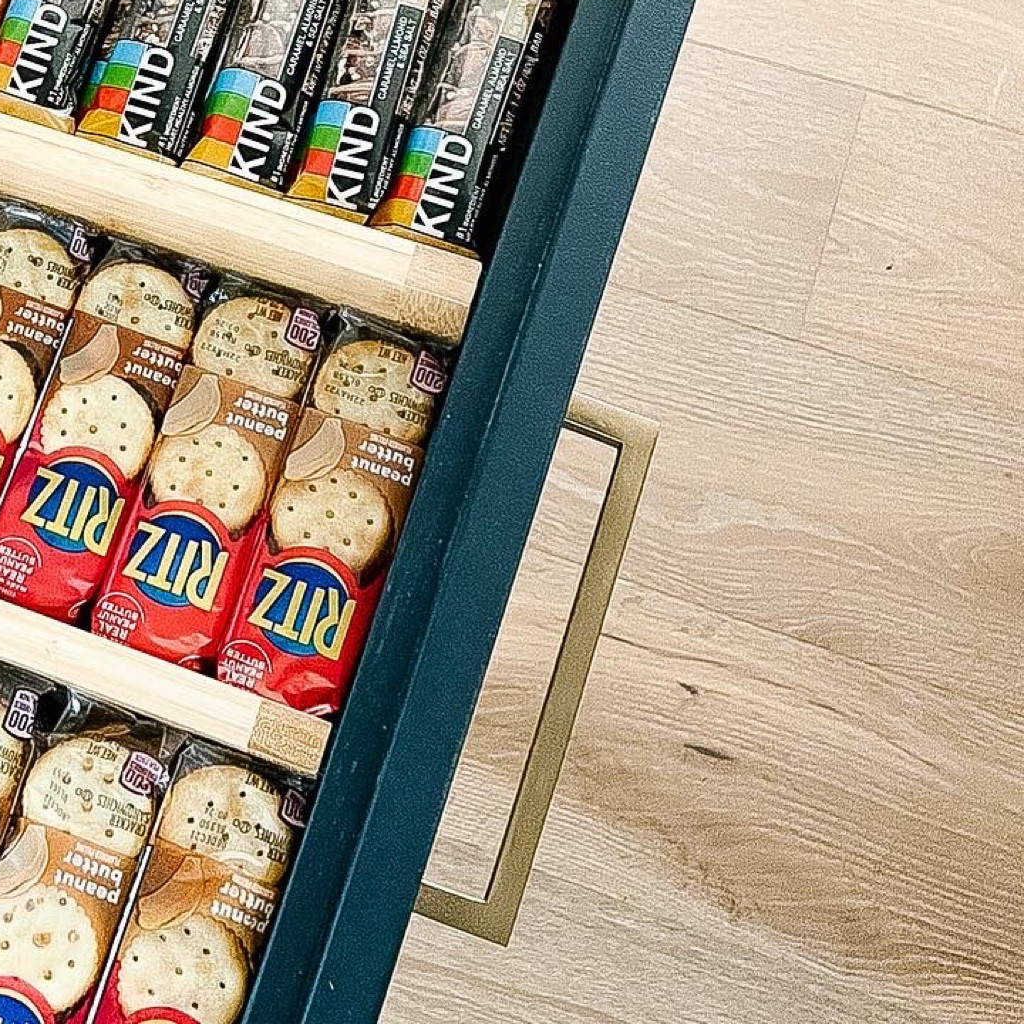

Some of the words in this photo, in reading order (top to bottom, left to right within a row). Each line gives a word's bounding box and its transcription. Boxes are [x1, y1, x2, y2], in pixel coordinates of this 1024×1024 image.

[7, 1, 68, 103] KIND
[119, 45, 175, 149] KIND
[228, 78, 288, 183] KIND
[326, 105, 380, 210] KIND
[410, 134, 472, 238] KIND
[290, 324, 317, 346] 200
[415, 365, 444, 387] 200
[226, 411, 287, 441] peanut
[235, 397, 290, 424] butter
[350, 456, 413, 486] peanut
[358, 441, 416, 471] butter
[20, 467, 125, 557] RITZ
[122, 521, 229, 613] RITZ
[248, 568, 357, 661] RITZ
[54, 869, 122, 905] peanut
[63, 851, 123, 883] butter
